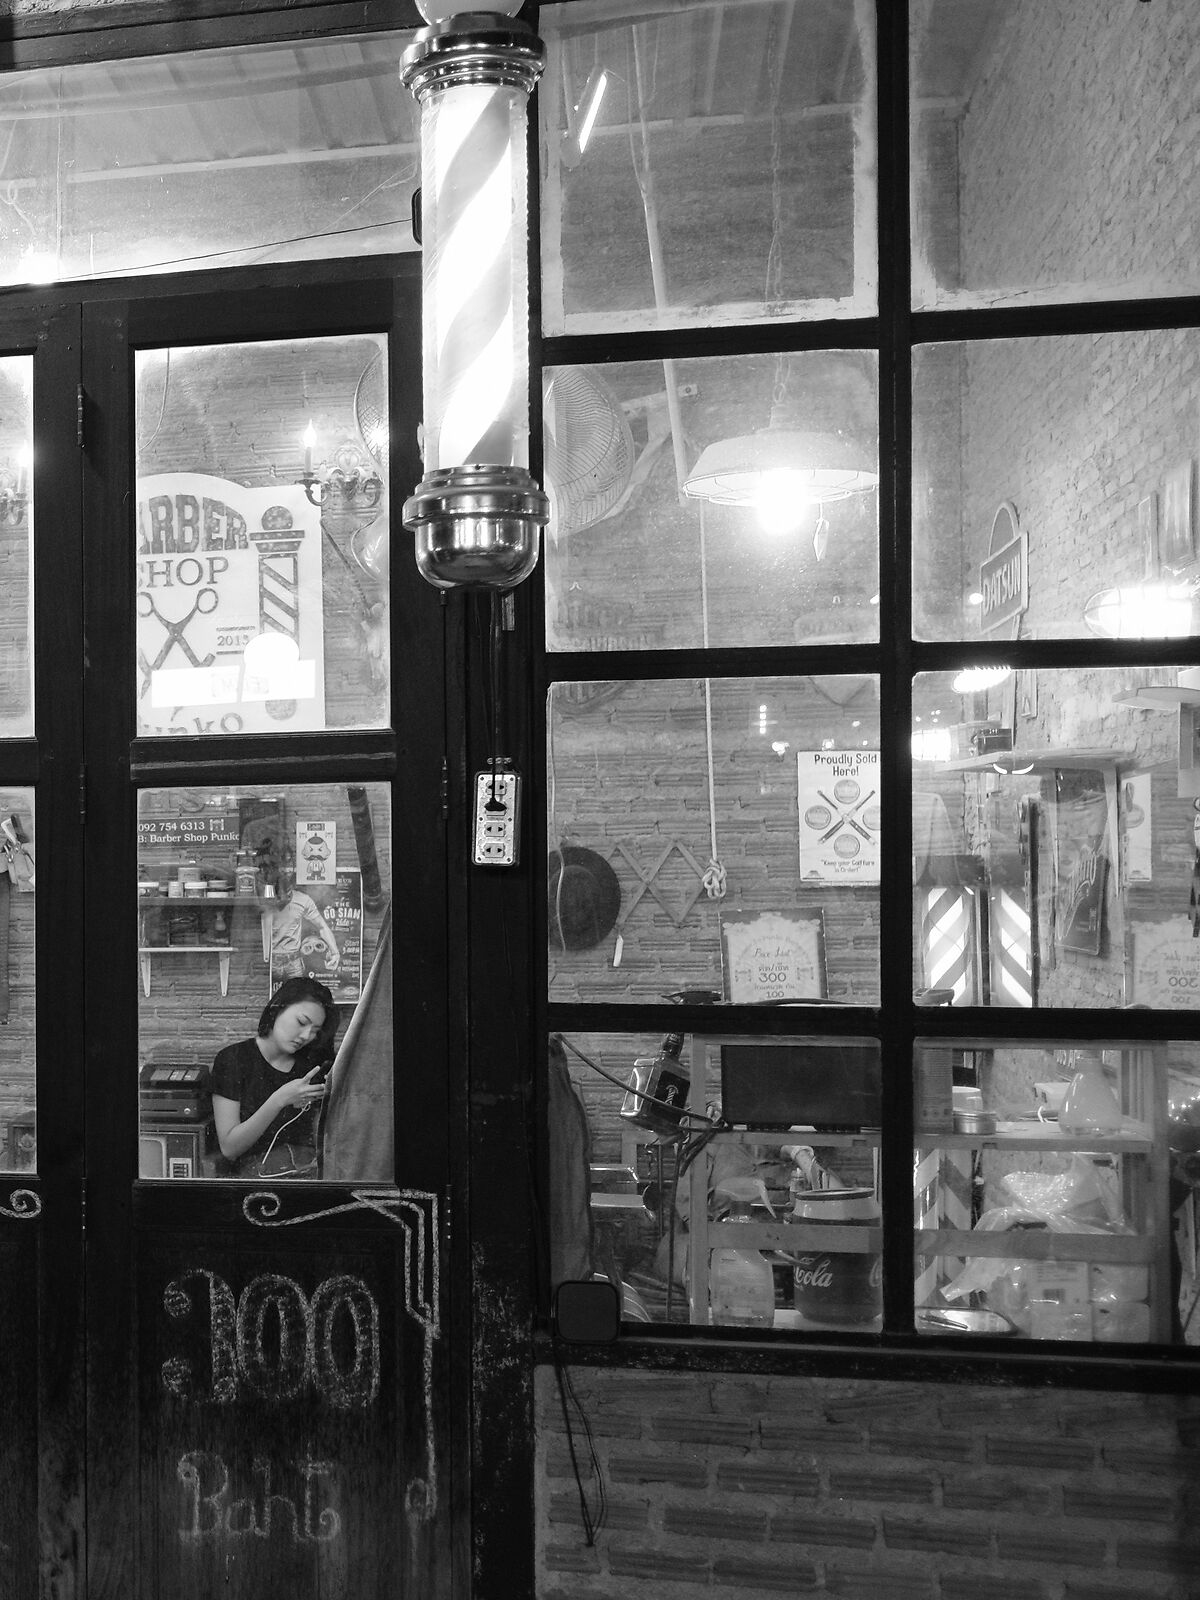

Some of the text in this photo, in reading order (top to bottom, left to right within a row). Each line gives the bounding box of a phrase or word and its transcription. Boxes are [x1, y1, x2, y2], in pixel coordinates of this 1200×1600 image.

[138, 557, 229, 588] HOP
[983, 552, 1021, 616] DATSUN
[814, 753, 878, 767] Proudly Sold
[833, 766, 859, 776] Here!
[138, 822, 205, 832] 092 754 6313
[150, 834, 182, 843] Barber
[184, 833, 208, 844] Shop
[323, 907, 361, 920] GO SIAM
[758, 972, 787, 983] 300
[176, 1441, 342, 1544] Baht
